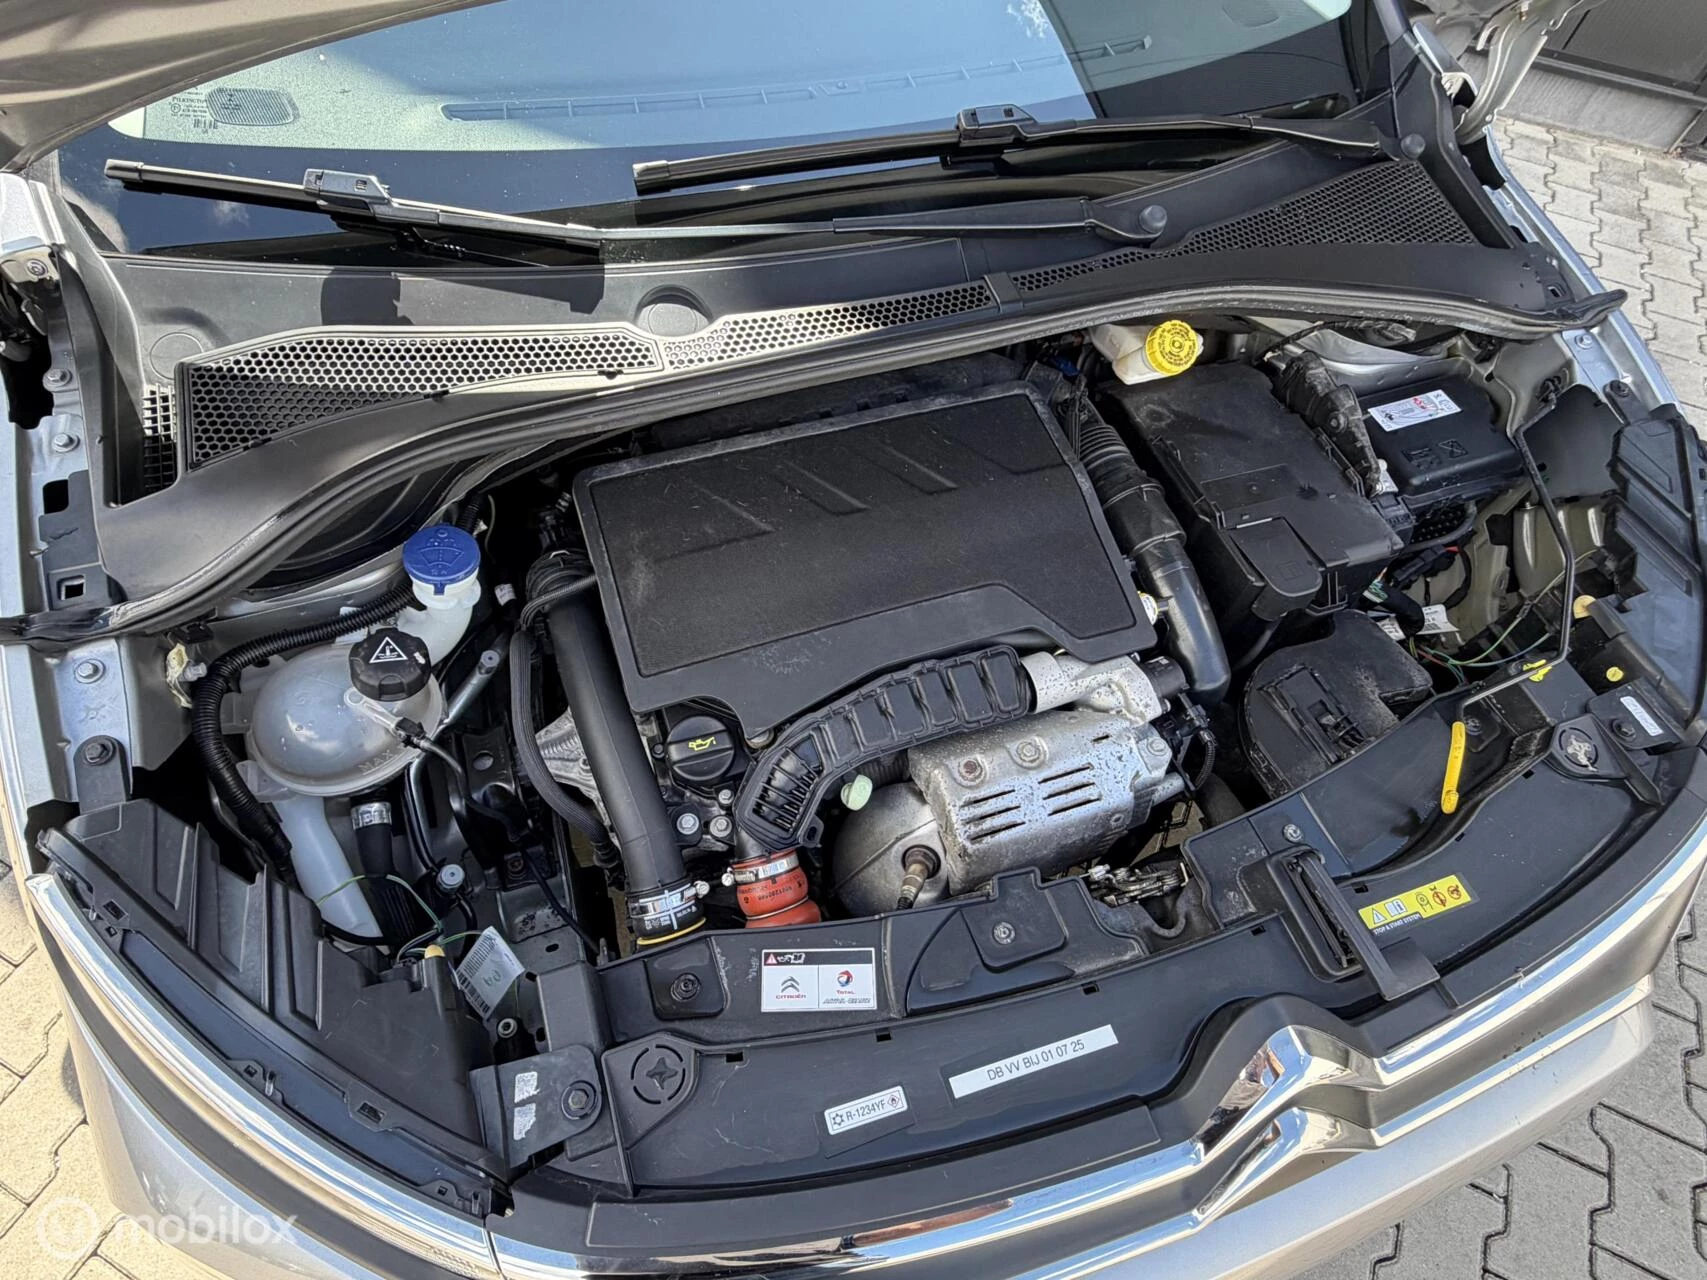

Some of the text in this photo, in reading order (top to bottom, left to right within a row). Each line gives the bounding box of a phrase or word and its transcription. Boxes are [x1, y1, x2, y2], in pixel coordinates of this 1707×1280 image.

[358, 749, 394, 772] MAX
[1373, 925, 1386, 935] STOP
[987, 1066, 1004, 1081] DB
[1004, 1060, 1020, 1074] VV
[1041, 1050, 1054, 1063] 01
[1055, 1044, 1068, 1058] 07
[1070, 1039, 1085, 1053] 25
[845, 1099, 887, 1122] R-1234YF
